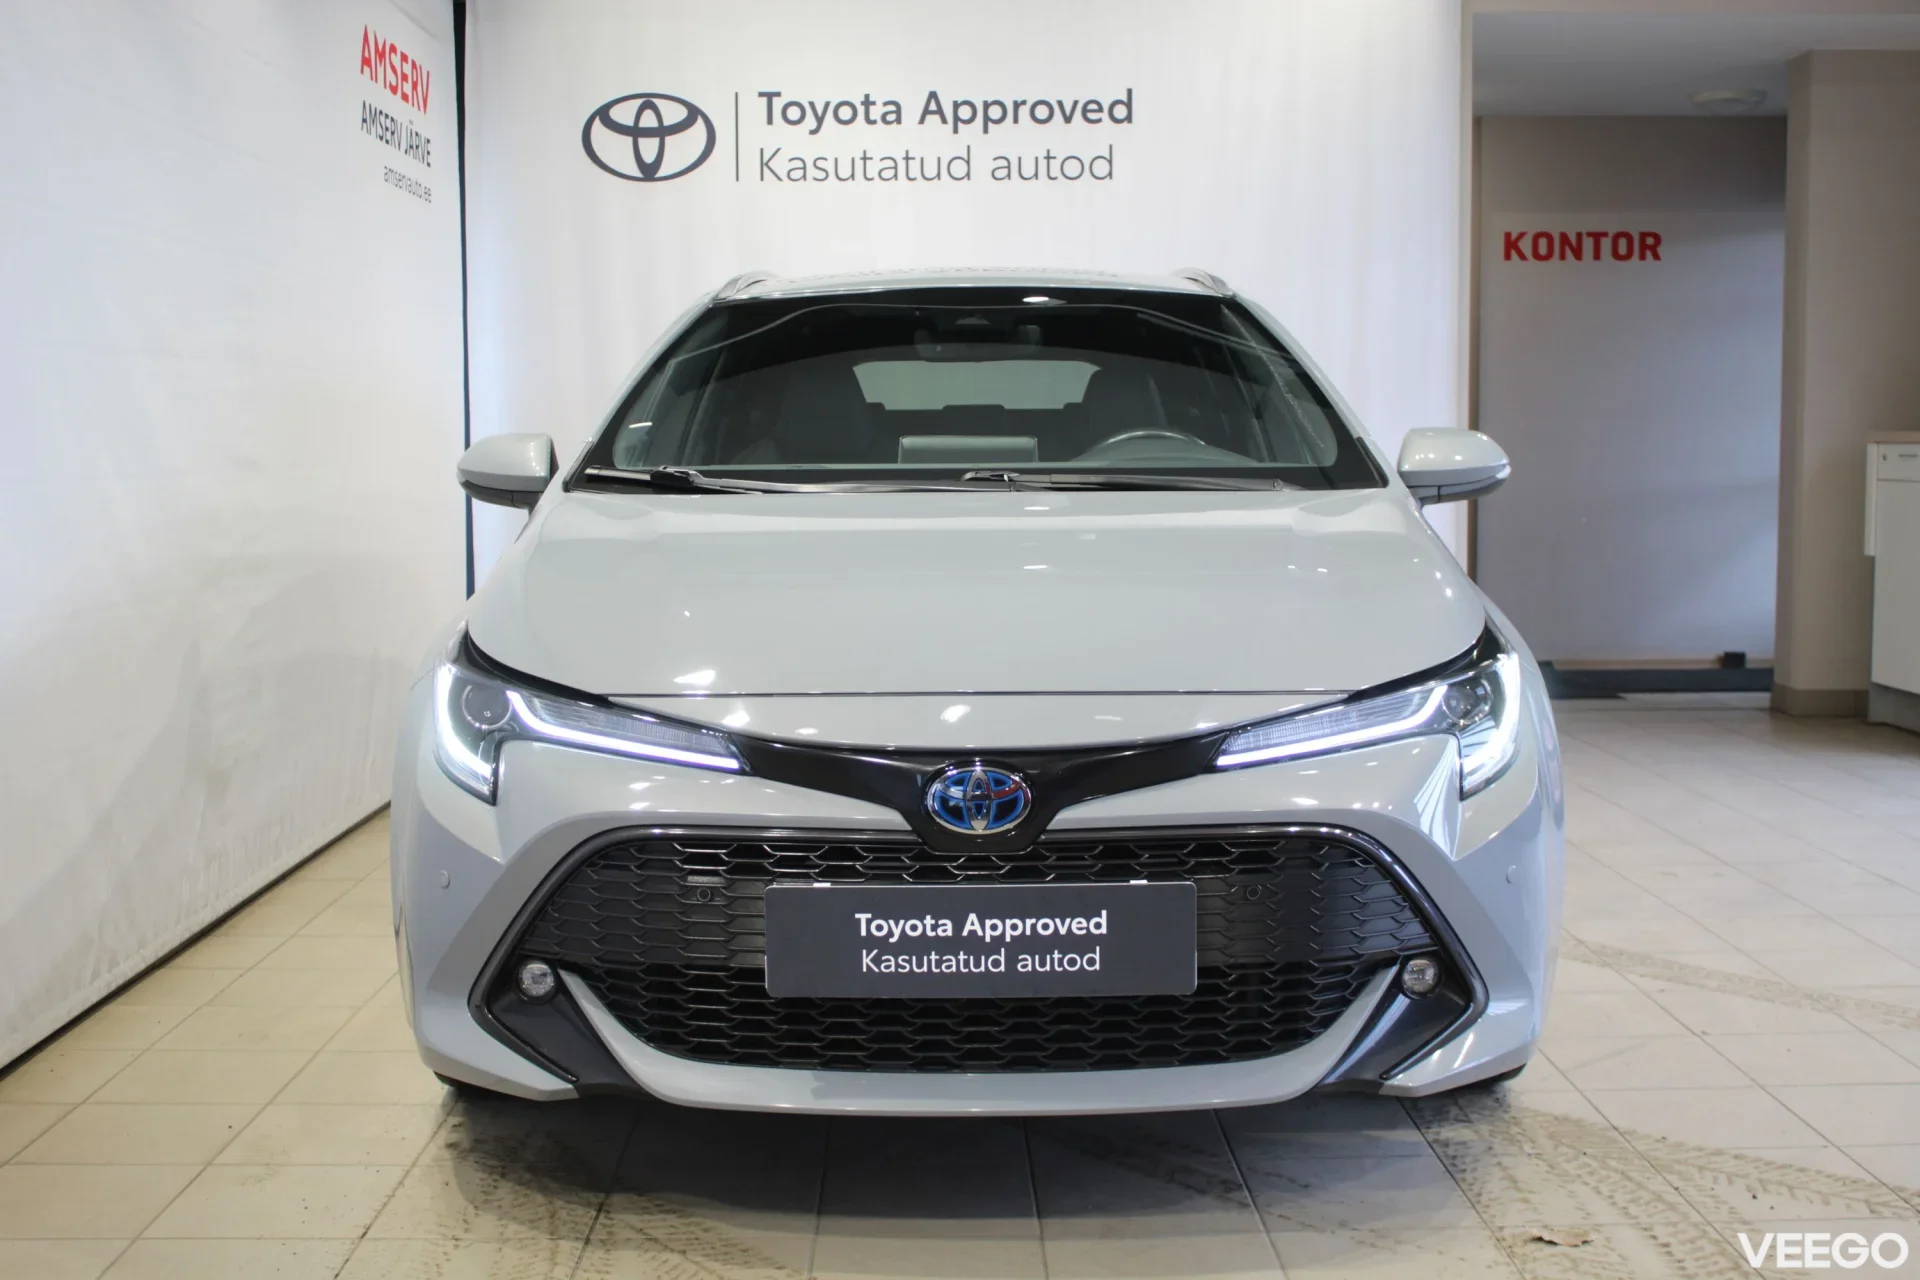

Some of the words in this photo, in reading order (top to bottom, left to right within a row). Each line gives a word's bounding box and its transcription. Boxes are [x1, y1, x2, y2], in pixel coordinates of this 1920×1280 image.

[360, 24, 430, 115] AMSERV
[758, 91, 902, 135] Toyota
[918, 88, 1135, 134] Approved
[361, 100, 403, 152] AMSERV
[404, 119, 431, 168] JÄRVE
[759, 145, 972, 183] Kasutatud
[990, 144, 1115, 182] autod
[383, 165, 432, 203] amservauto.ee
[1503, 231, 1662, 262] KONTOR
[855, 913, 953, 942] Toyota
[962, 910, 1107, 942] Approved
[862, 948, 1005, 973] Kasutatud
[1017, 946, 1101, 972] autod
